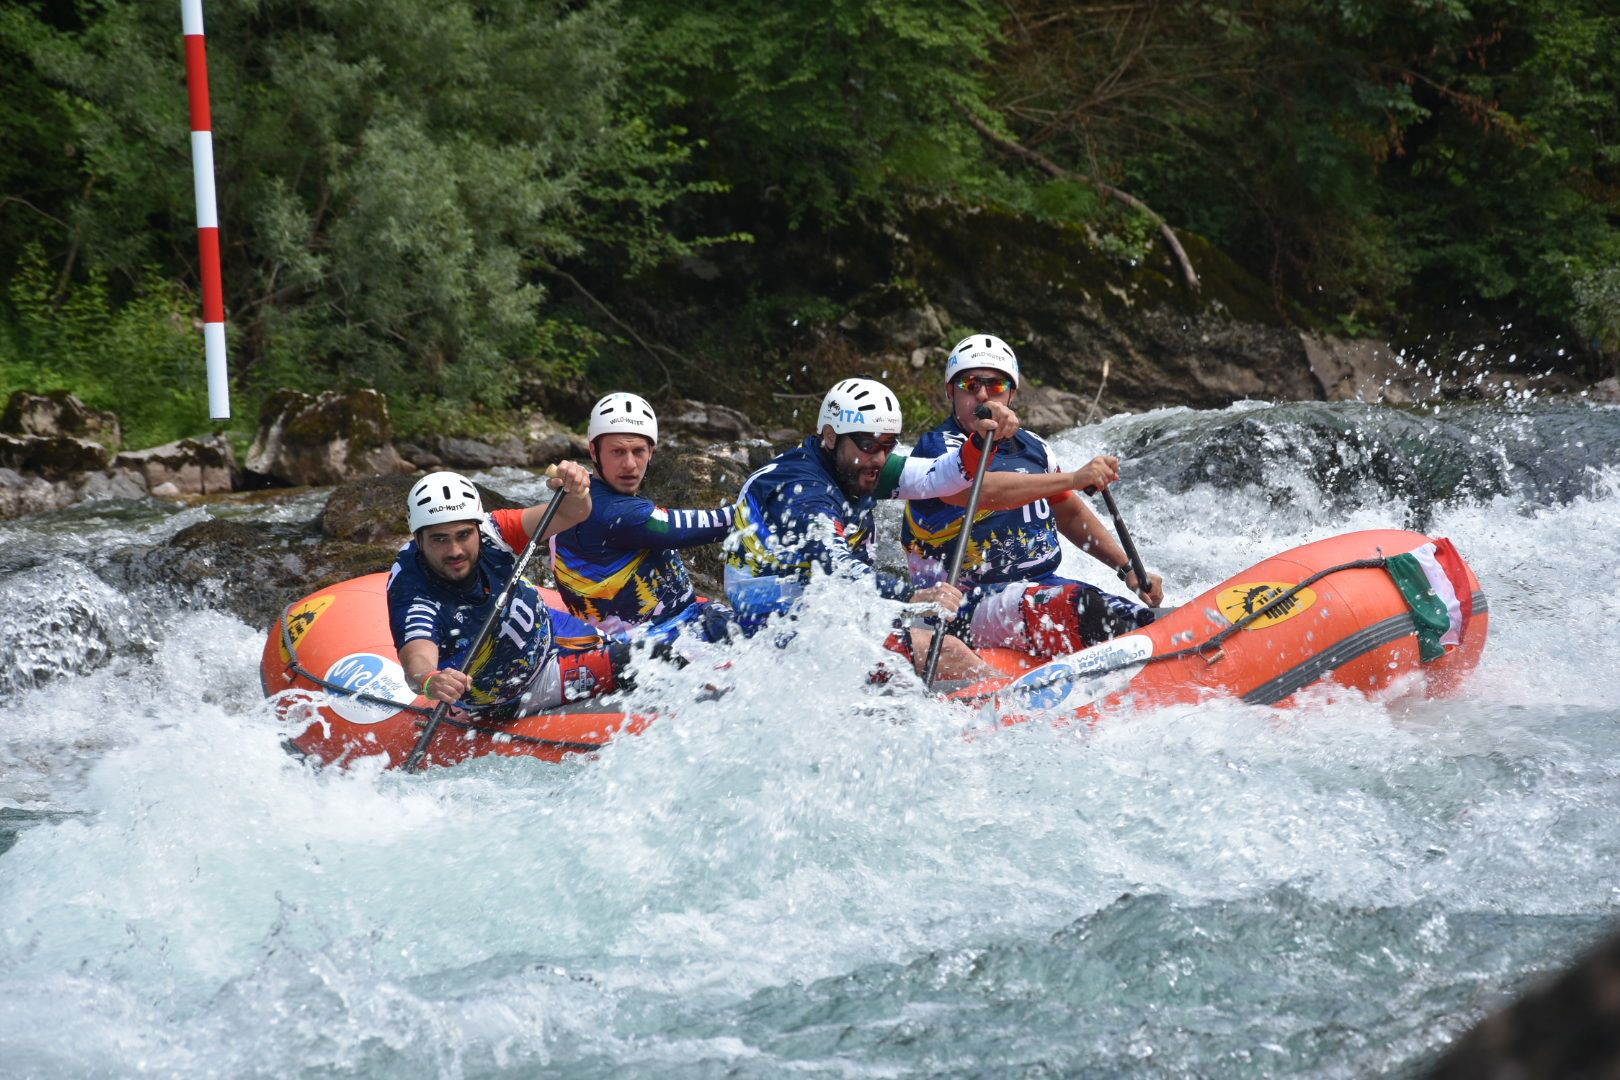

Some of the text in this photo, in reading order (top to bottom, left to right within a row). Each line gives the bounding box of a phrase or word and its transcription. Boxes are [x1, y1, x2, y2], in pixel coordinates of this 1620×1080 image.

[839, 409, 865, 424] ITA
[427, 502, 467, 515] WILD-WATER
[498, 597, 535, 650] 10
